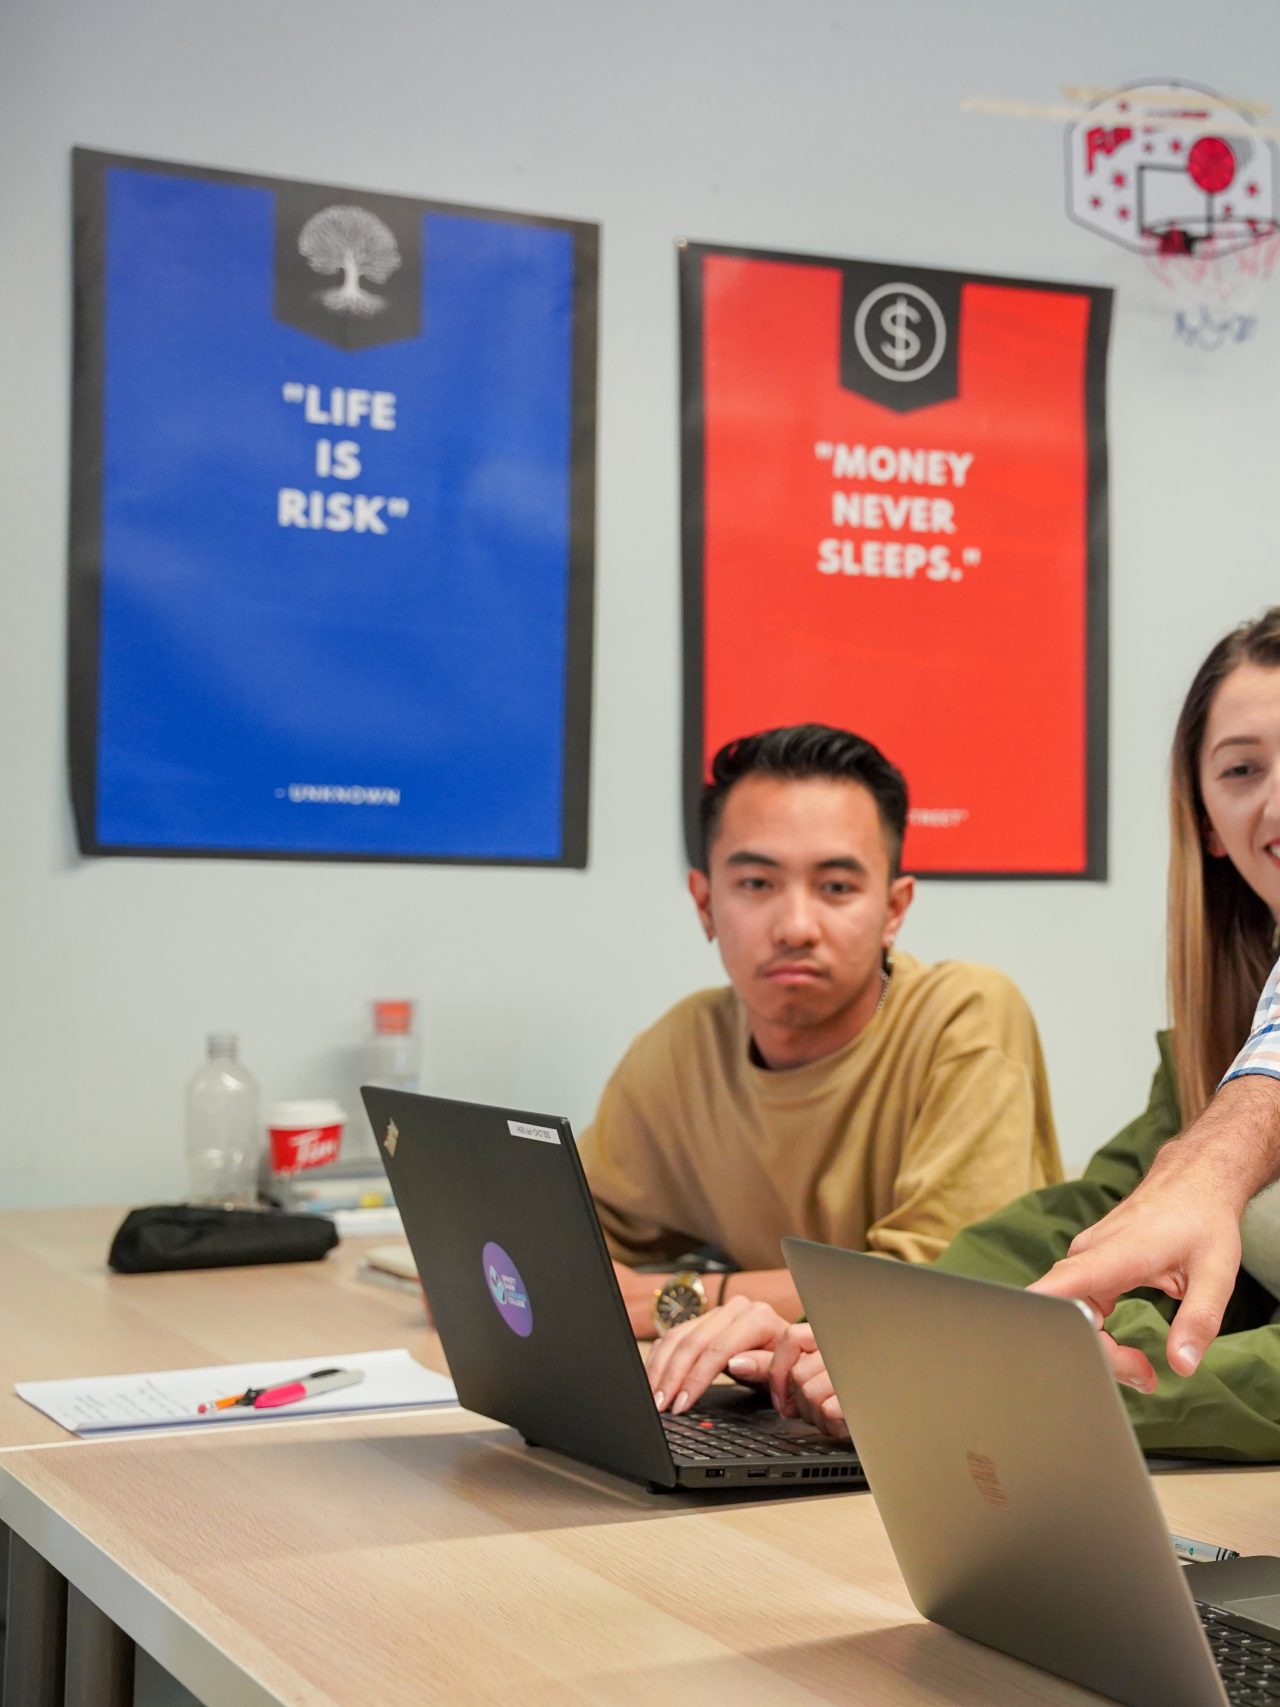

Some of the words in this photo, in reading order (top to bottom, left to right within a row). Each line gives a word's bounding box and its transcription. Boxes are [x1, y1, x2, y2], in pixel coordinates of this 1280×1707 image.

[282, 381, 397, 431] "LIFE
[315, 438, 362, 481] IS
[814, 441, 974, 487] "MONEY
[277, 487, 410, 536] RISK"
[832, 490, 956, 535] NEVER
[816, 537, 982, 582] SLEEPS."
[288, 782, 401, 806] UNKNOWN
